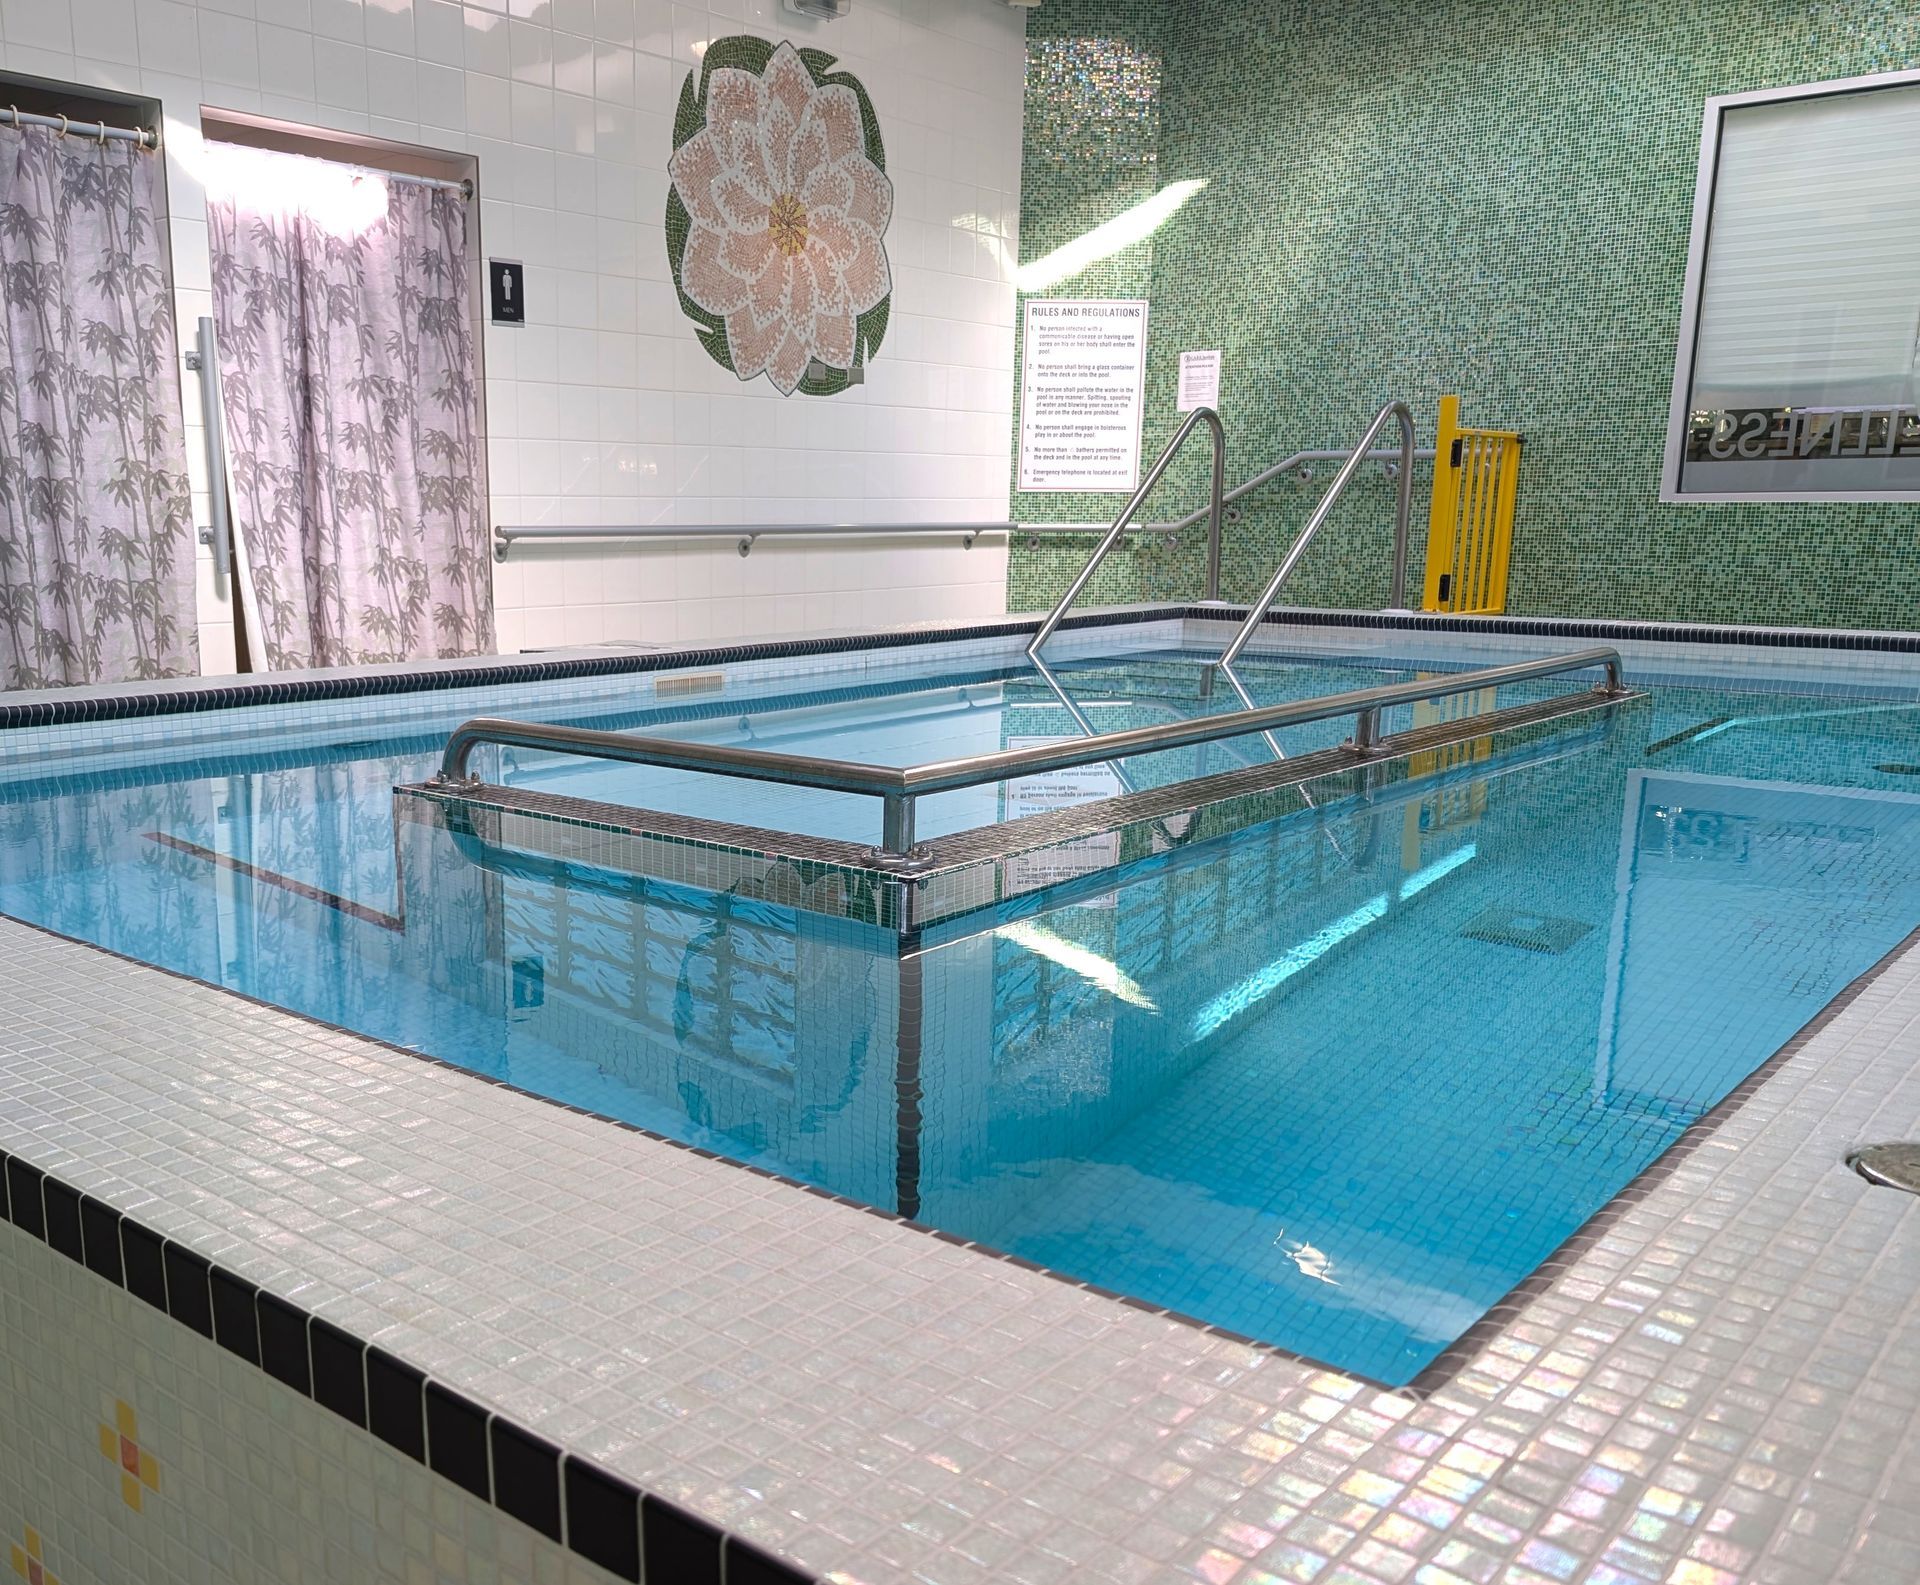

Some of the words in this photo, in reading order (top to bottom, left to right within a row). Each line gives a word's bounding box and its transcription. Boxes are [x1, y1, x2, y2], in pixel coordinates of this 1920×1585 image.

[1032, 308, 1059, 317] RULES
[1062, 308, 1079, 317] AND
[1082, 308, 1140, 317] REGULATIONS
